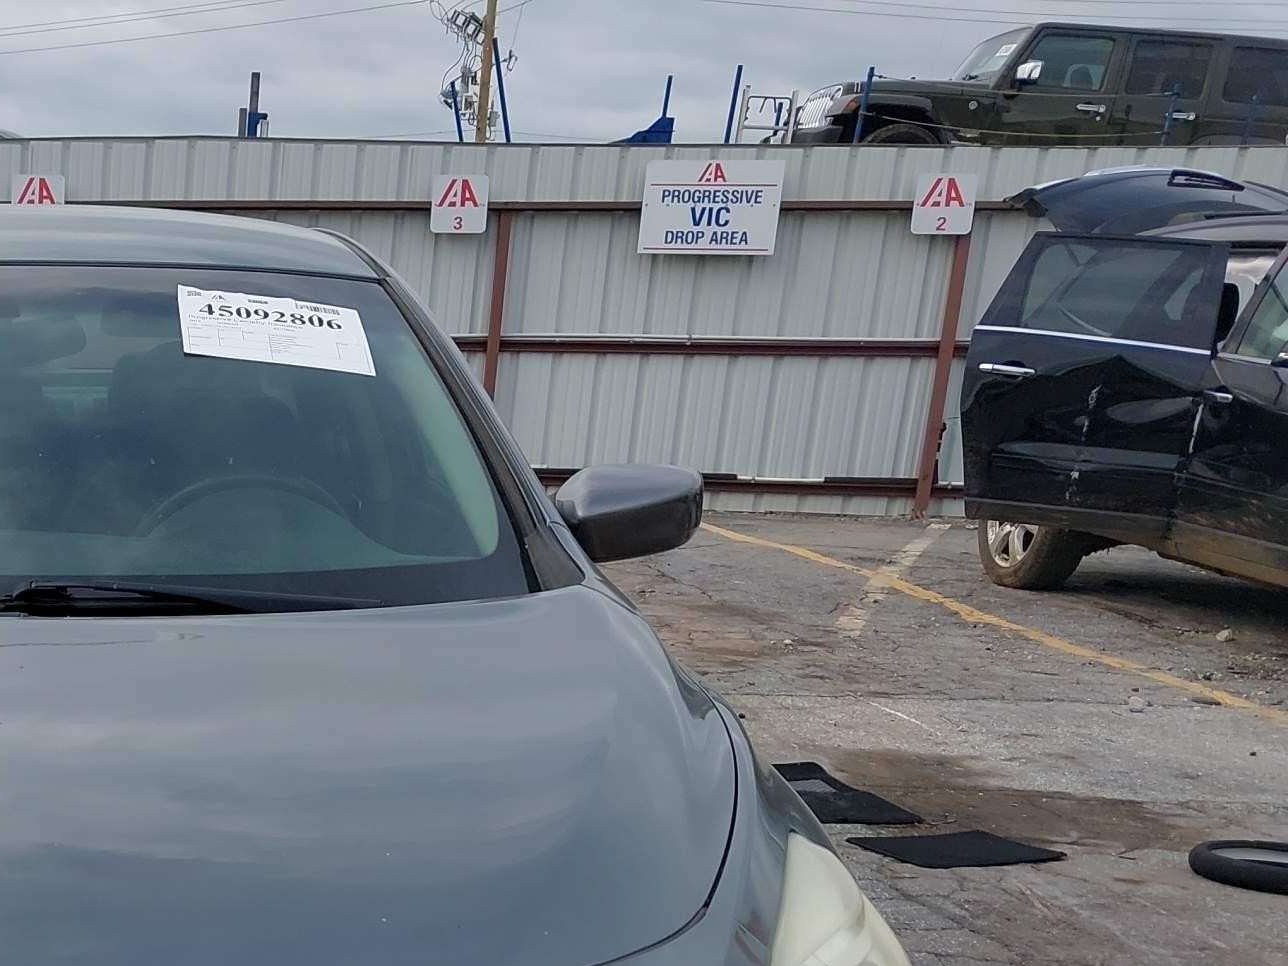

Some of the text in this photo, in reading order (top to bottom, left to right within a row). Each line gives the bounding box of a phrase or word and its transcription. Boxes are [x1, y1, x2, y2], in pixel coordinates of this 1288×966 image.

[661, 189, 763, 204] PROGRESSIVE
[453, 216, 463, 230] 3
[690, 206, 731, 227] VIC
[935, 216, 947, 231] 2
[664, 230, 749, 245] DROP AREA
[198, 303, 343, 330] 45092806
